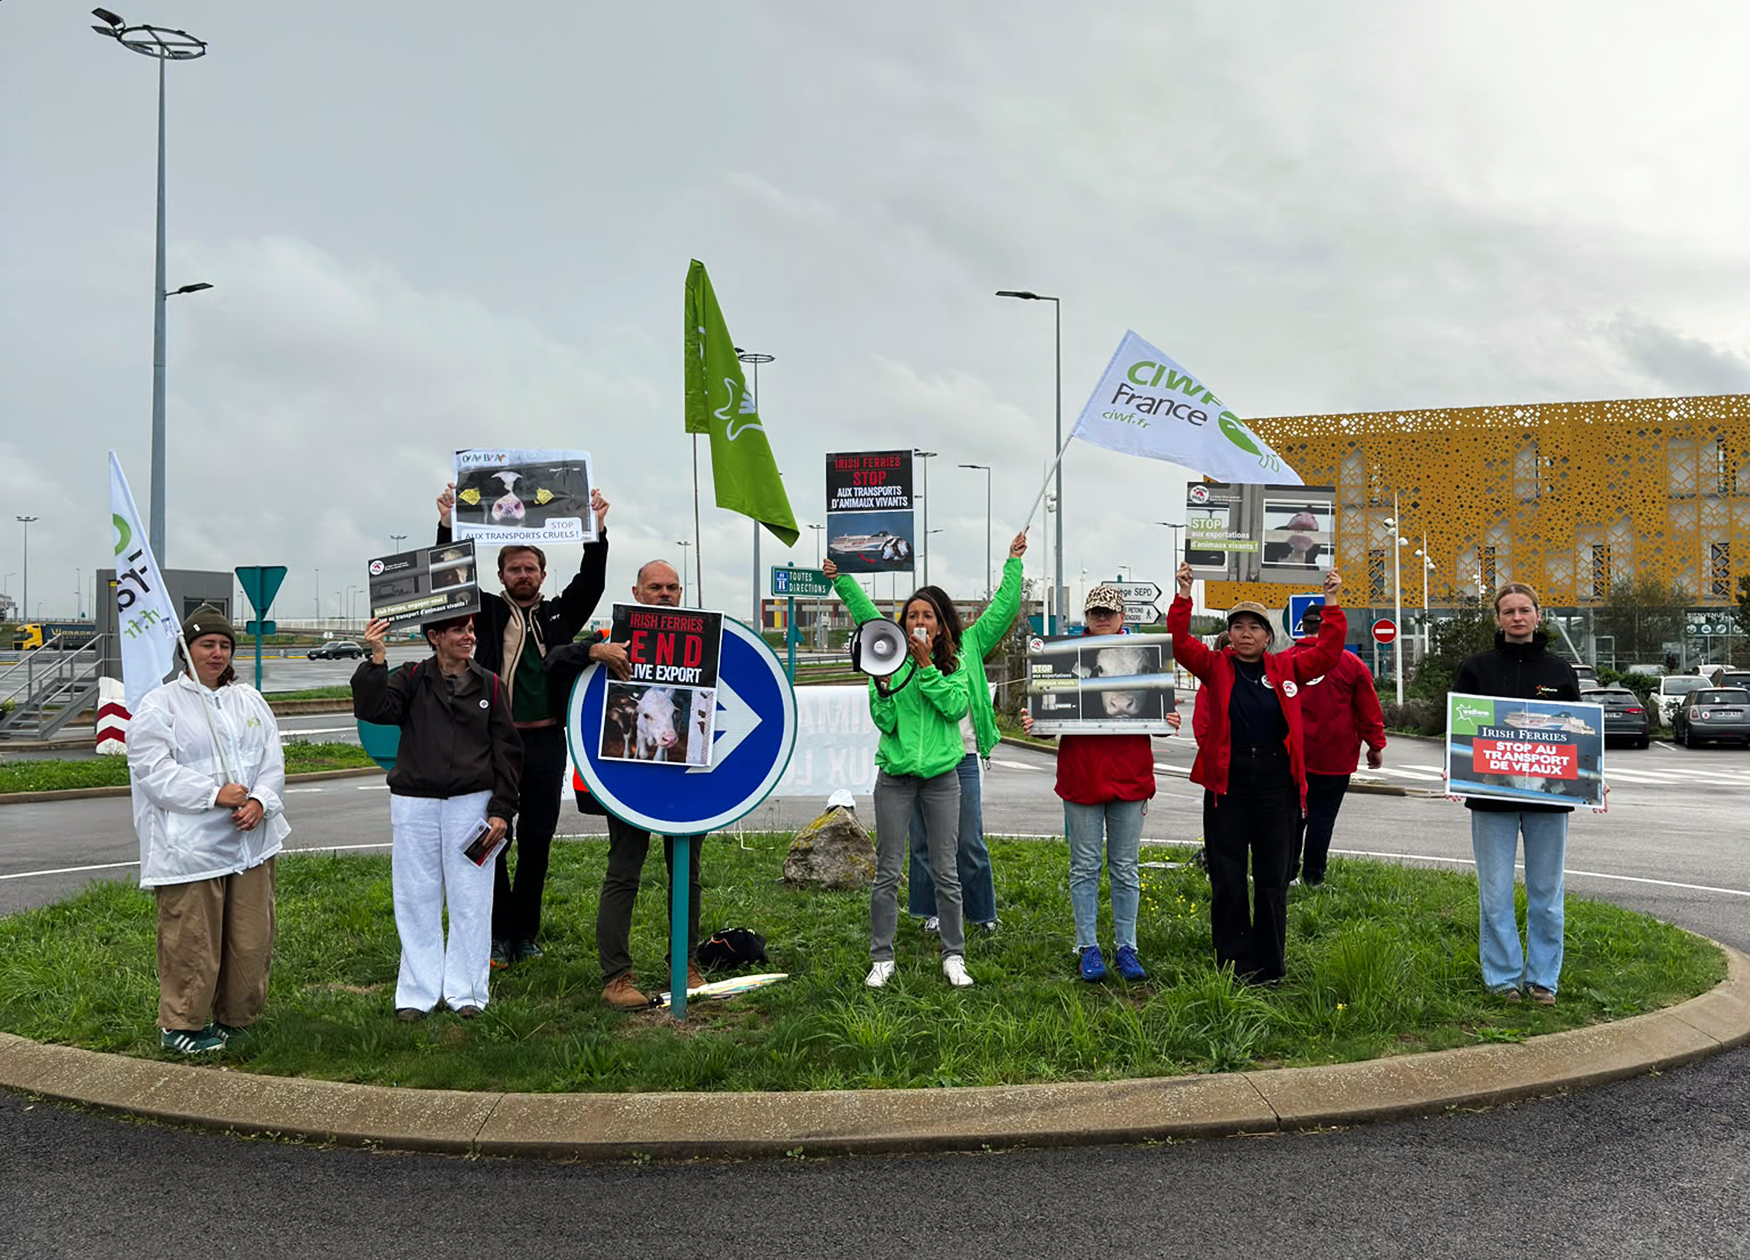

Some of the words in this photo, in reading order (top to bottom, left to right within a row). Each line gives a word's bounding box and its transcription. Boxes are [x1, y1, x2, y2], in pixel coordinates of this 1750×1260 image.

[1127, 361, 1224, 406] CIWF
[1111, 383, 1208, 427] France
[1102, 410, 1151, 429] ciwf.fr
[835, 458, 859, 469] IRISH
[863, 457, 901, 468] FERRIES
[853, 471, 887, 486] STOP
[837, 487, 853, 498] AUX
[854, 486, 902, 497] TRANSPORTS
[831, 498, 875, 509] D'ANIMAUX
[875, 497, 908, 507] VIVANTS
[551, 521, 574, 529] STOP
[1191, 519, 1222, 529] STOP
[465, 532, 484, 541] AUX
[485, 531, 541, 540] TRANSPORTS
[543, 531, 575, 539] CRUELS
[1205, 531, 1250, 540] exportations
[1191, 540, 1227, 549] d'animaux
[1228, 541, 1254, 550] vivants
[789, 572, 813, 582] TOUTES
[789, 583, 826, 593] DIRECTIONS
[630, 612, 659, 628] IRISH
[660, 615, 703, 632] FERRIES
[630, 630, 703, 668] END
[656, 665, 702, 683] EXPORT
[1032, 664, 1053, 674] STOP
[1482, 727, 1514, 739] IRISH
[1519, 729, 1567, 742] FERRIES
[1496, 742, 1532, 753] STOP
[1536, 744, 1556, 755] AU
[1483, 750, 1570, 766] TRANSPORT
[1490, 760, 1509, 770] DE
[1512, 762, 1562, 775] VEAUX
